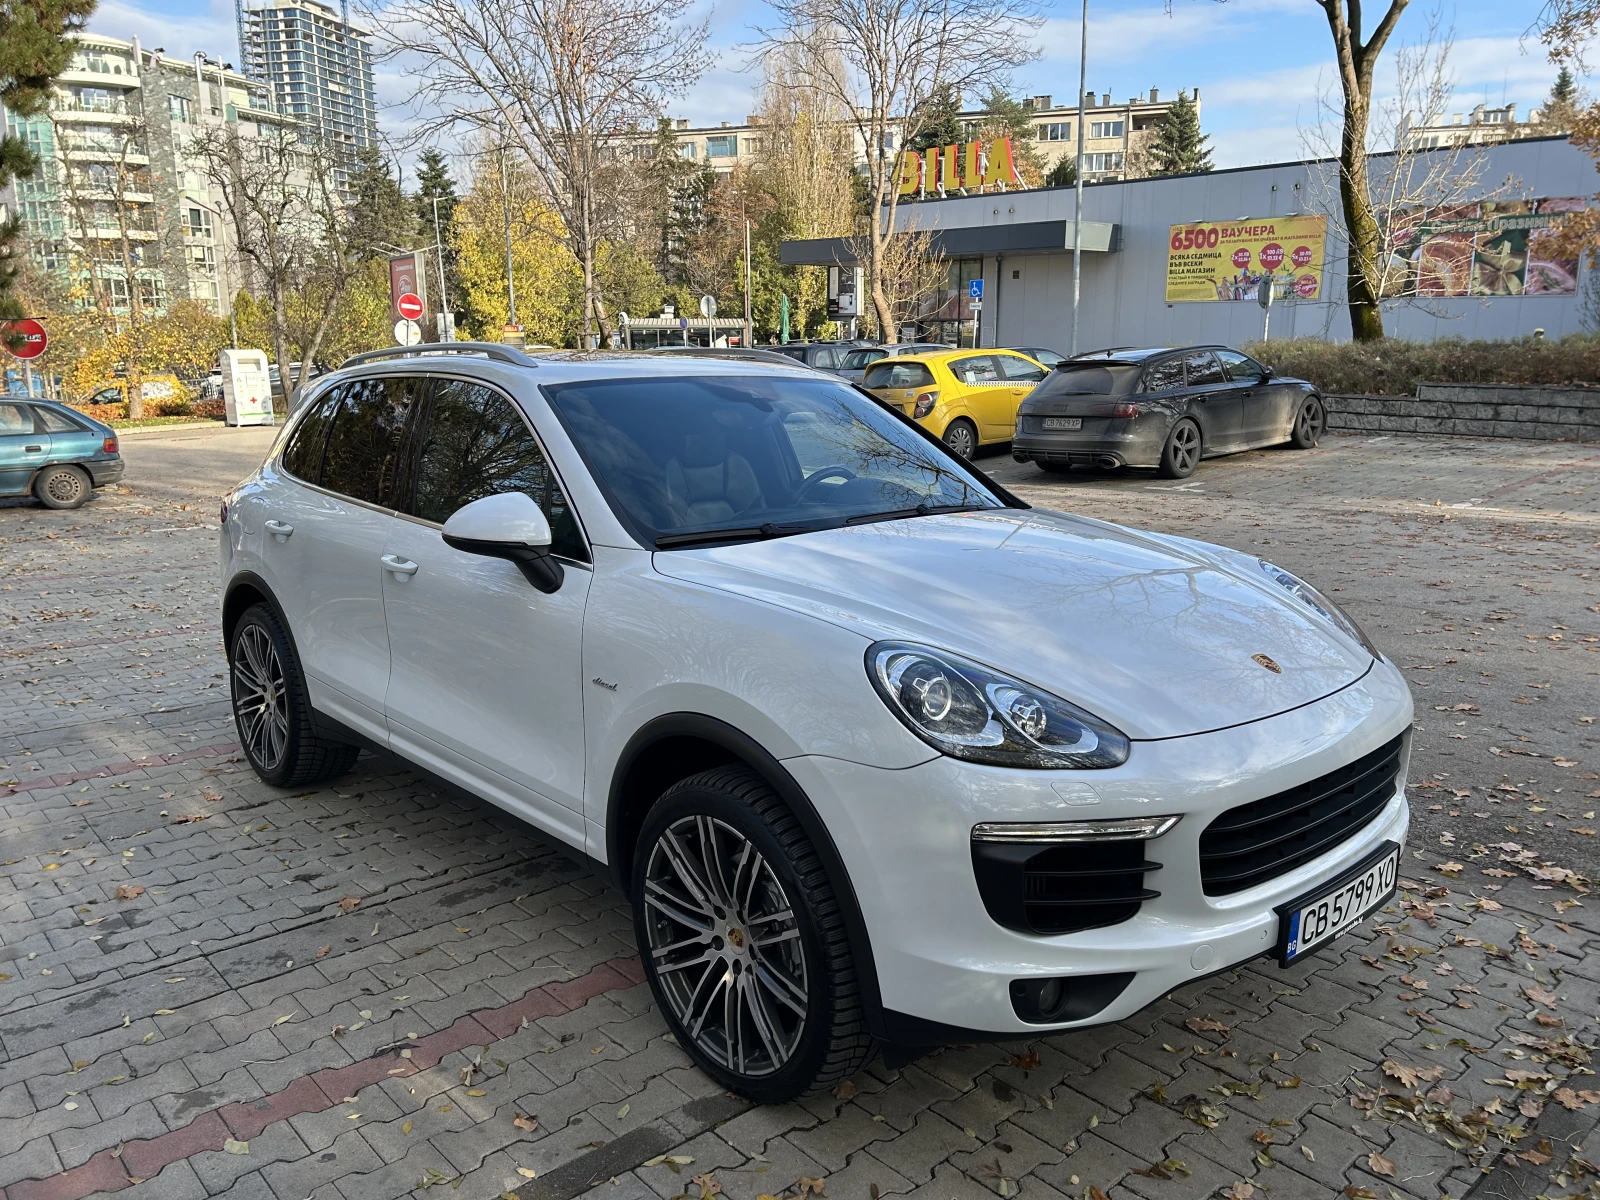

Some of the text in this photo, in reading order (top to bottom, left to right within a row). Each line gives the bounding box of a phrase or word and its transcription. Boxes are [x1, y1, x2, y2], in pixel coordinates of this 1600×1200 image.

[893, 137, 1016, 194] BILLA
[1221, 225, 1275, 238] ВАУЧЕРА
[1171, 228, 1219, 250] 6500
[1190, 252, 1222, 260] СЕДМИЦА
[1260, 252, 1267, 260] 1x
[1301, 901, 1329, 945] CB
[1331, 872, 1374, 928] 5799
[1375, 856, 1395, 899] XO
[1287, 940, 1297, 953] BG
